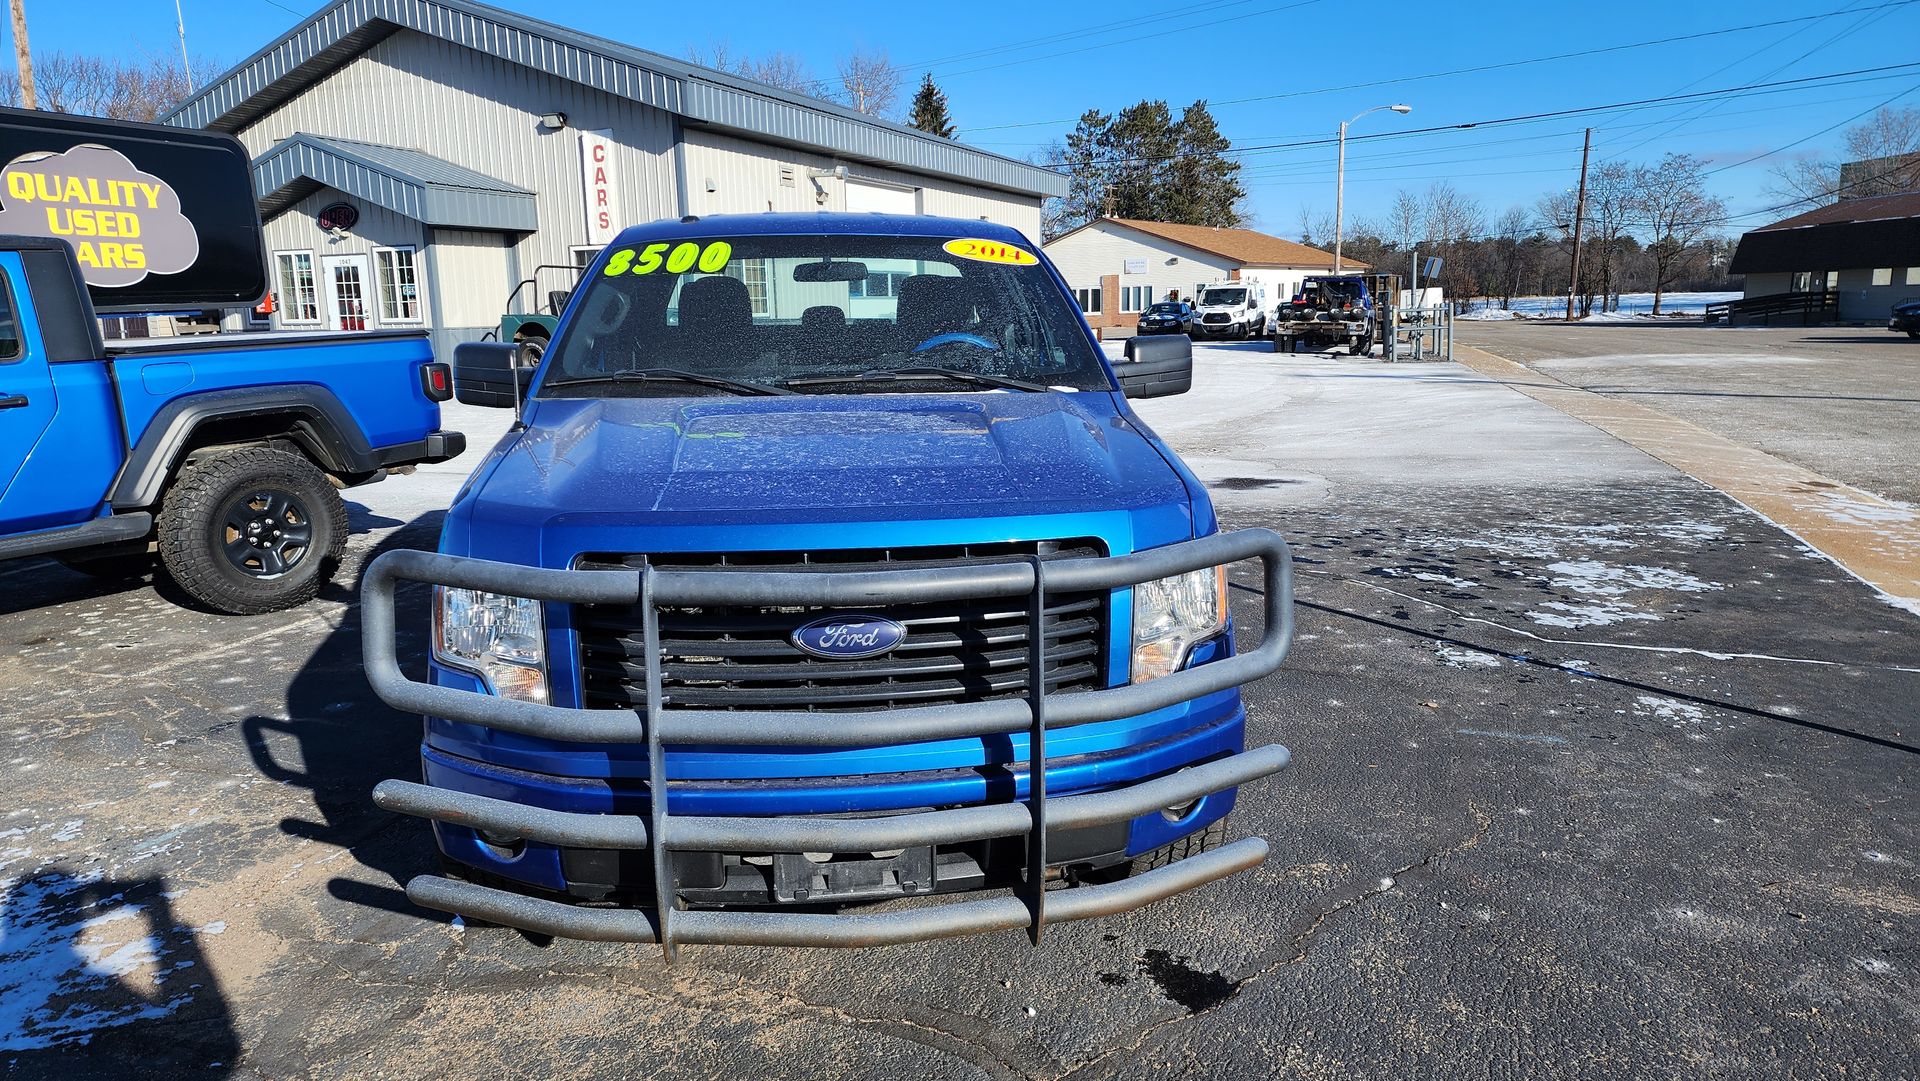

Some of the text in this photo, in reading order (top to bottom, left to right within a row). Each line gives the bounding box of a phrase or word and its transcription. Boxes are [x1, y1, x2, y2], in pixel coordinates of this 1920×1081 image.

[7, 171, 161, 209] QUALITY
[593, 144, 610, 230] CARS
[46, 207, 141, 238] USED
[77, 241, 146, 269] ARS
[603, 241, 732, 276] 8500
[964, 243, 1022, 261] 2014
[819, 622, 880, 648] Ford
